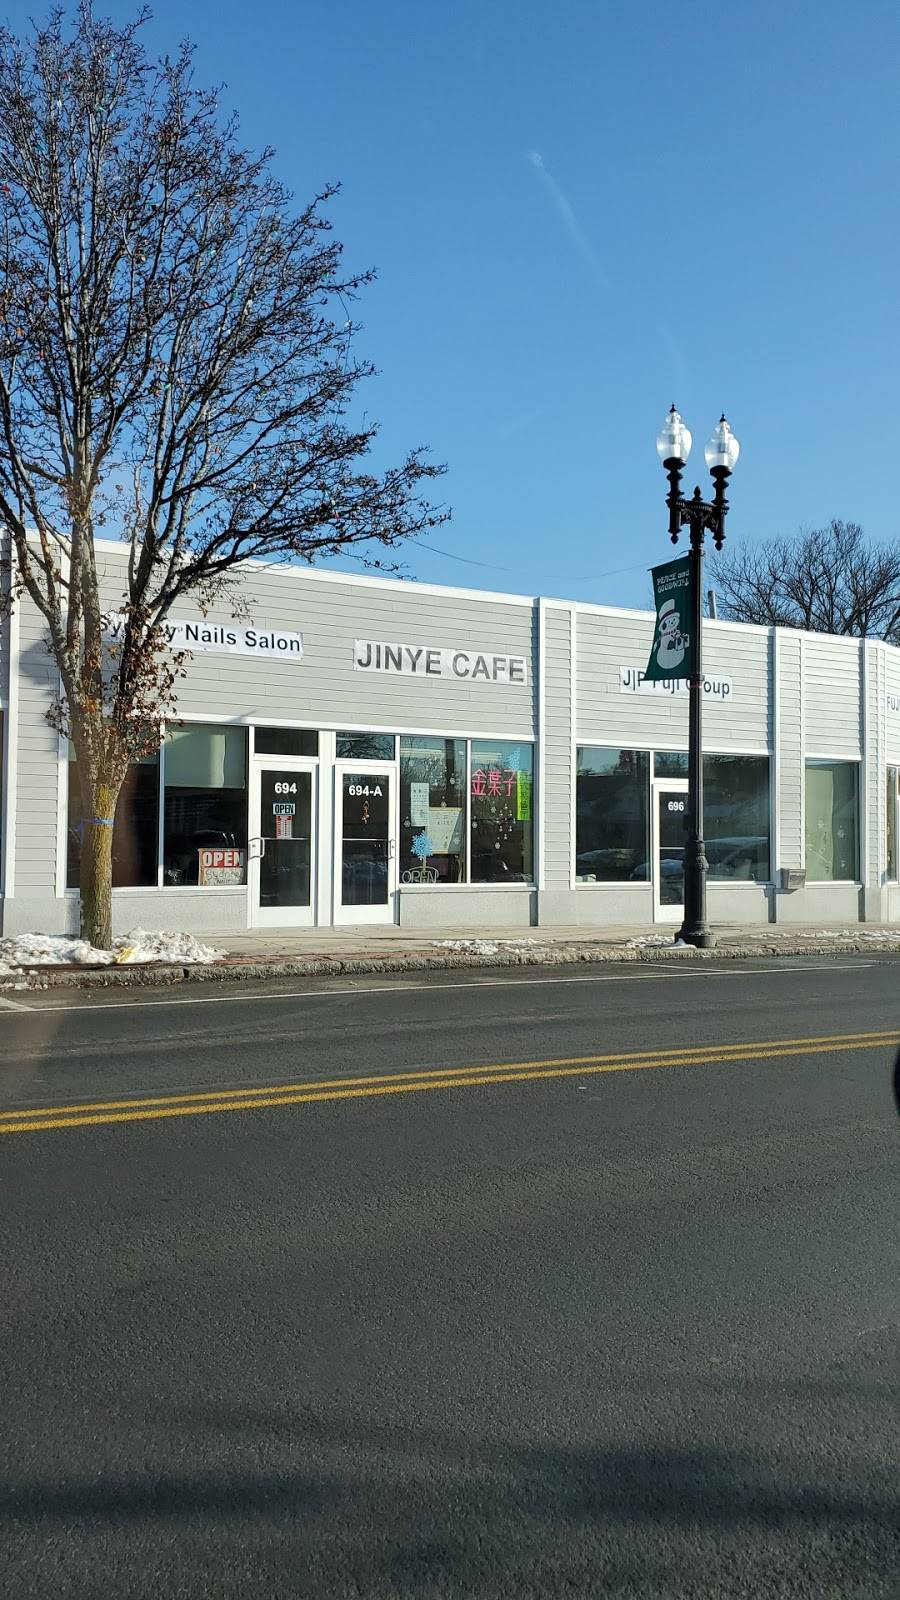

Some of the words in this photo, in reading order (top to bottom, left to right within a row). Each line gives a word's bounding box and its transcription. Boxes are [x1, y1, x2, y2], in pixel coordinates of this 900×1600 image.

[186, 624, 237, 645] Nails
[245, 630, 301, 652] Salon
[357, 643, 442, 676] JINYE
[452, 653, 525, 683] CAFE
[274, 782, 298, 794] 694
[348, 785, 383, 797] 694-A
[274, 804, 294, 814] OPEN
[667, 801, 685, 812] 696
[202, 851, 244, 867] OPEN
[402, 869, 438, 884] OPEN
